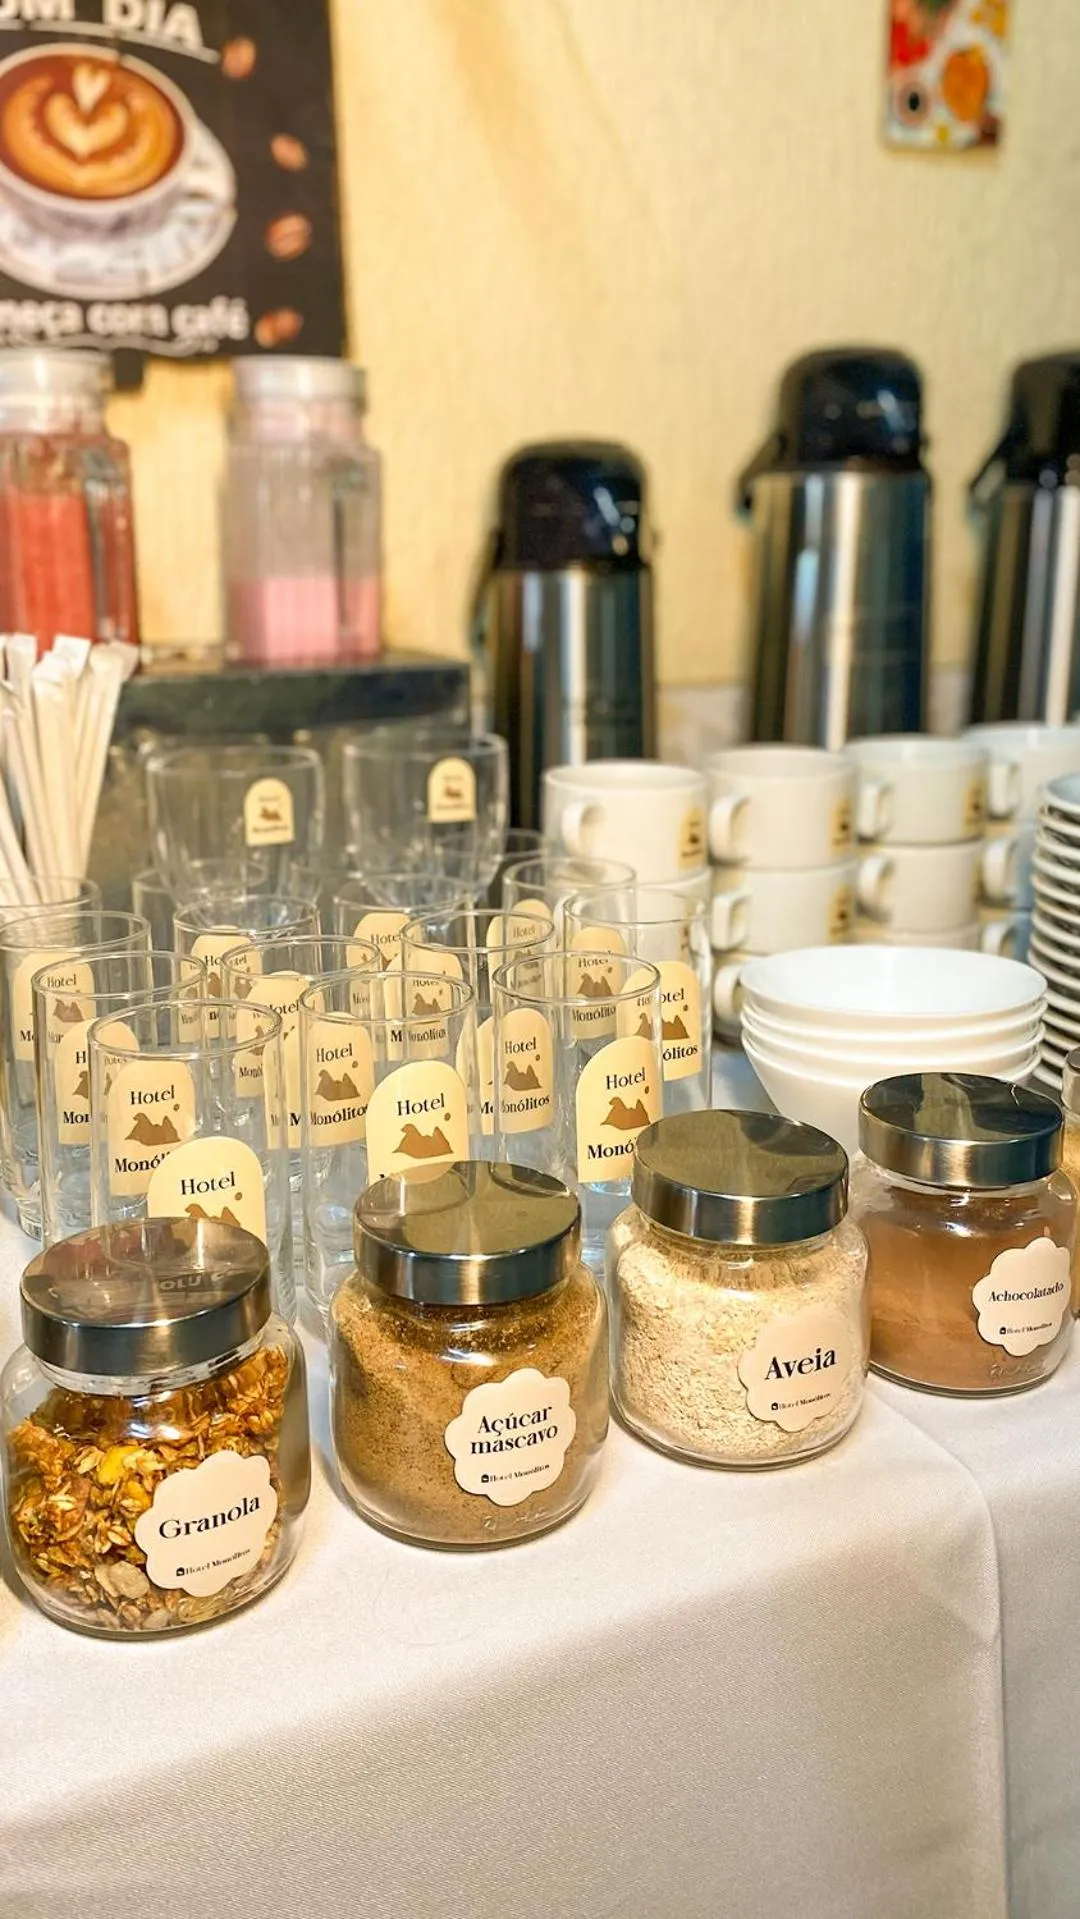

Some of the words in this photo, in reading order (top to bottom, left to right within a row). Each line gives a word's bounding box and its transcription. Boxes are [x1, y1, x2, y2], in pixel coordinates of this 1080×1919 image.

[316, 1042, 354, 1063] Hotel
[504, 1036, 537, 1054] Hotel
[662, 1044, 699, 1062] ólitos
[606, 1066, 647, 1091] Hotel
[130, 1084, 176, 1106] Hotel
[397, 1092, 446, 1117] Hotel
[180, 1170, 237, 1196] Hotel
[988, 1282, 1065, 1303] Achocolatado
[764, 1347, 837, 1381] Aveia
[476, 1405, 553, 1436] Açúcar
[470, 1425, 559, 1455] mascavo
[158, 1495, 261, 1540] Granola
